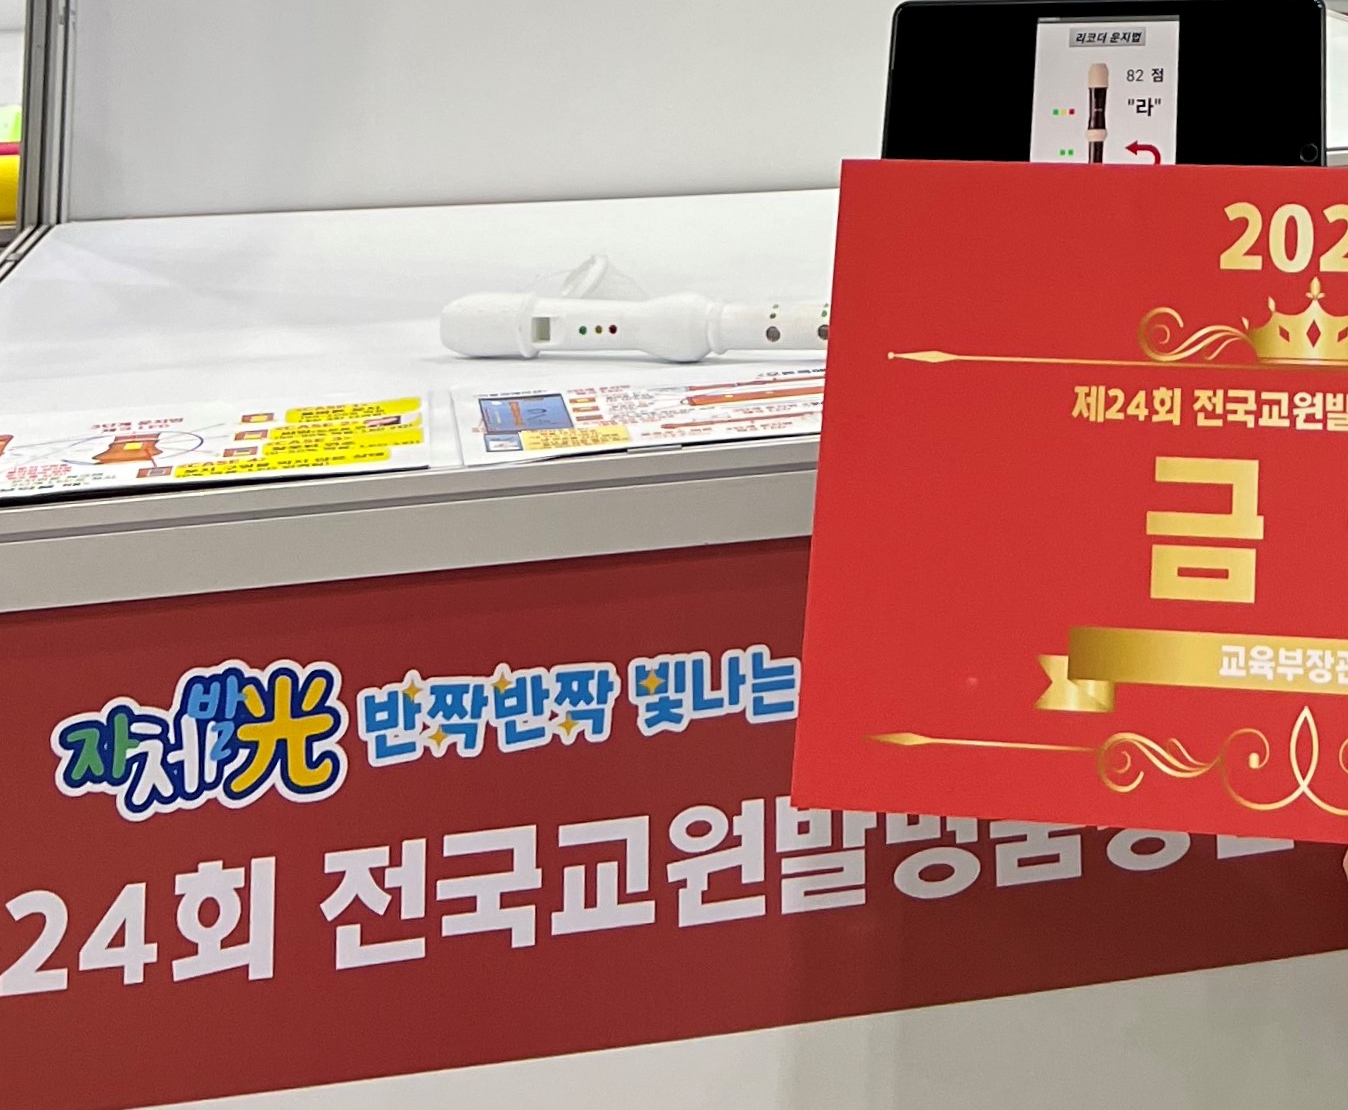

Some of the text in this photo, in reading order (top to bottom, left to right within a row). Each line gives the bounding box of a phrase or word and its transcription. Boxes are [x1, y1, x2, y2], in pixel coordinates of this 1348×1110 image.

[1076, 32, 1142, 44] 리코더 운지법
[1126, 68, 1164, 83] 82 점
[1127, 97, 1162, 118] "라"
[1071, 385, 1182, 426] 제24회
[1145, 456, 1265, 604] 금
[364, 662, 616, 752] 반짝반짝
[634, 646, 798, 728] 빛나는
[0, 798, 1294, 997] 24회 전국교원발명
